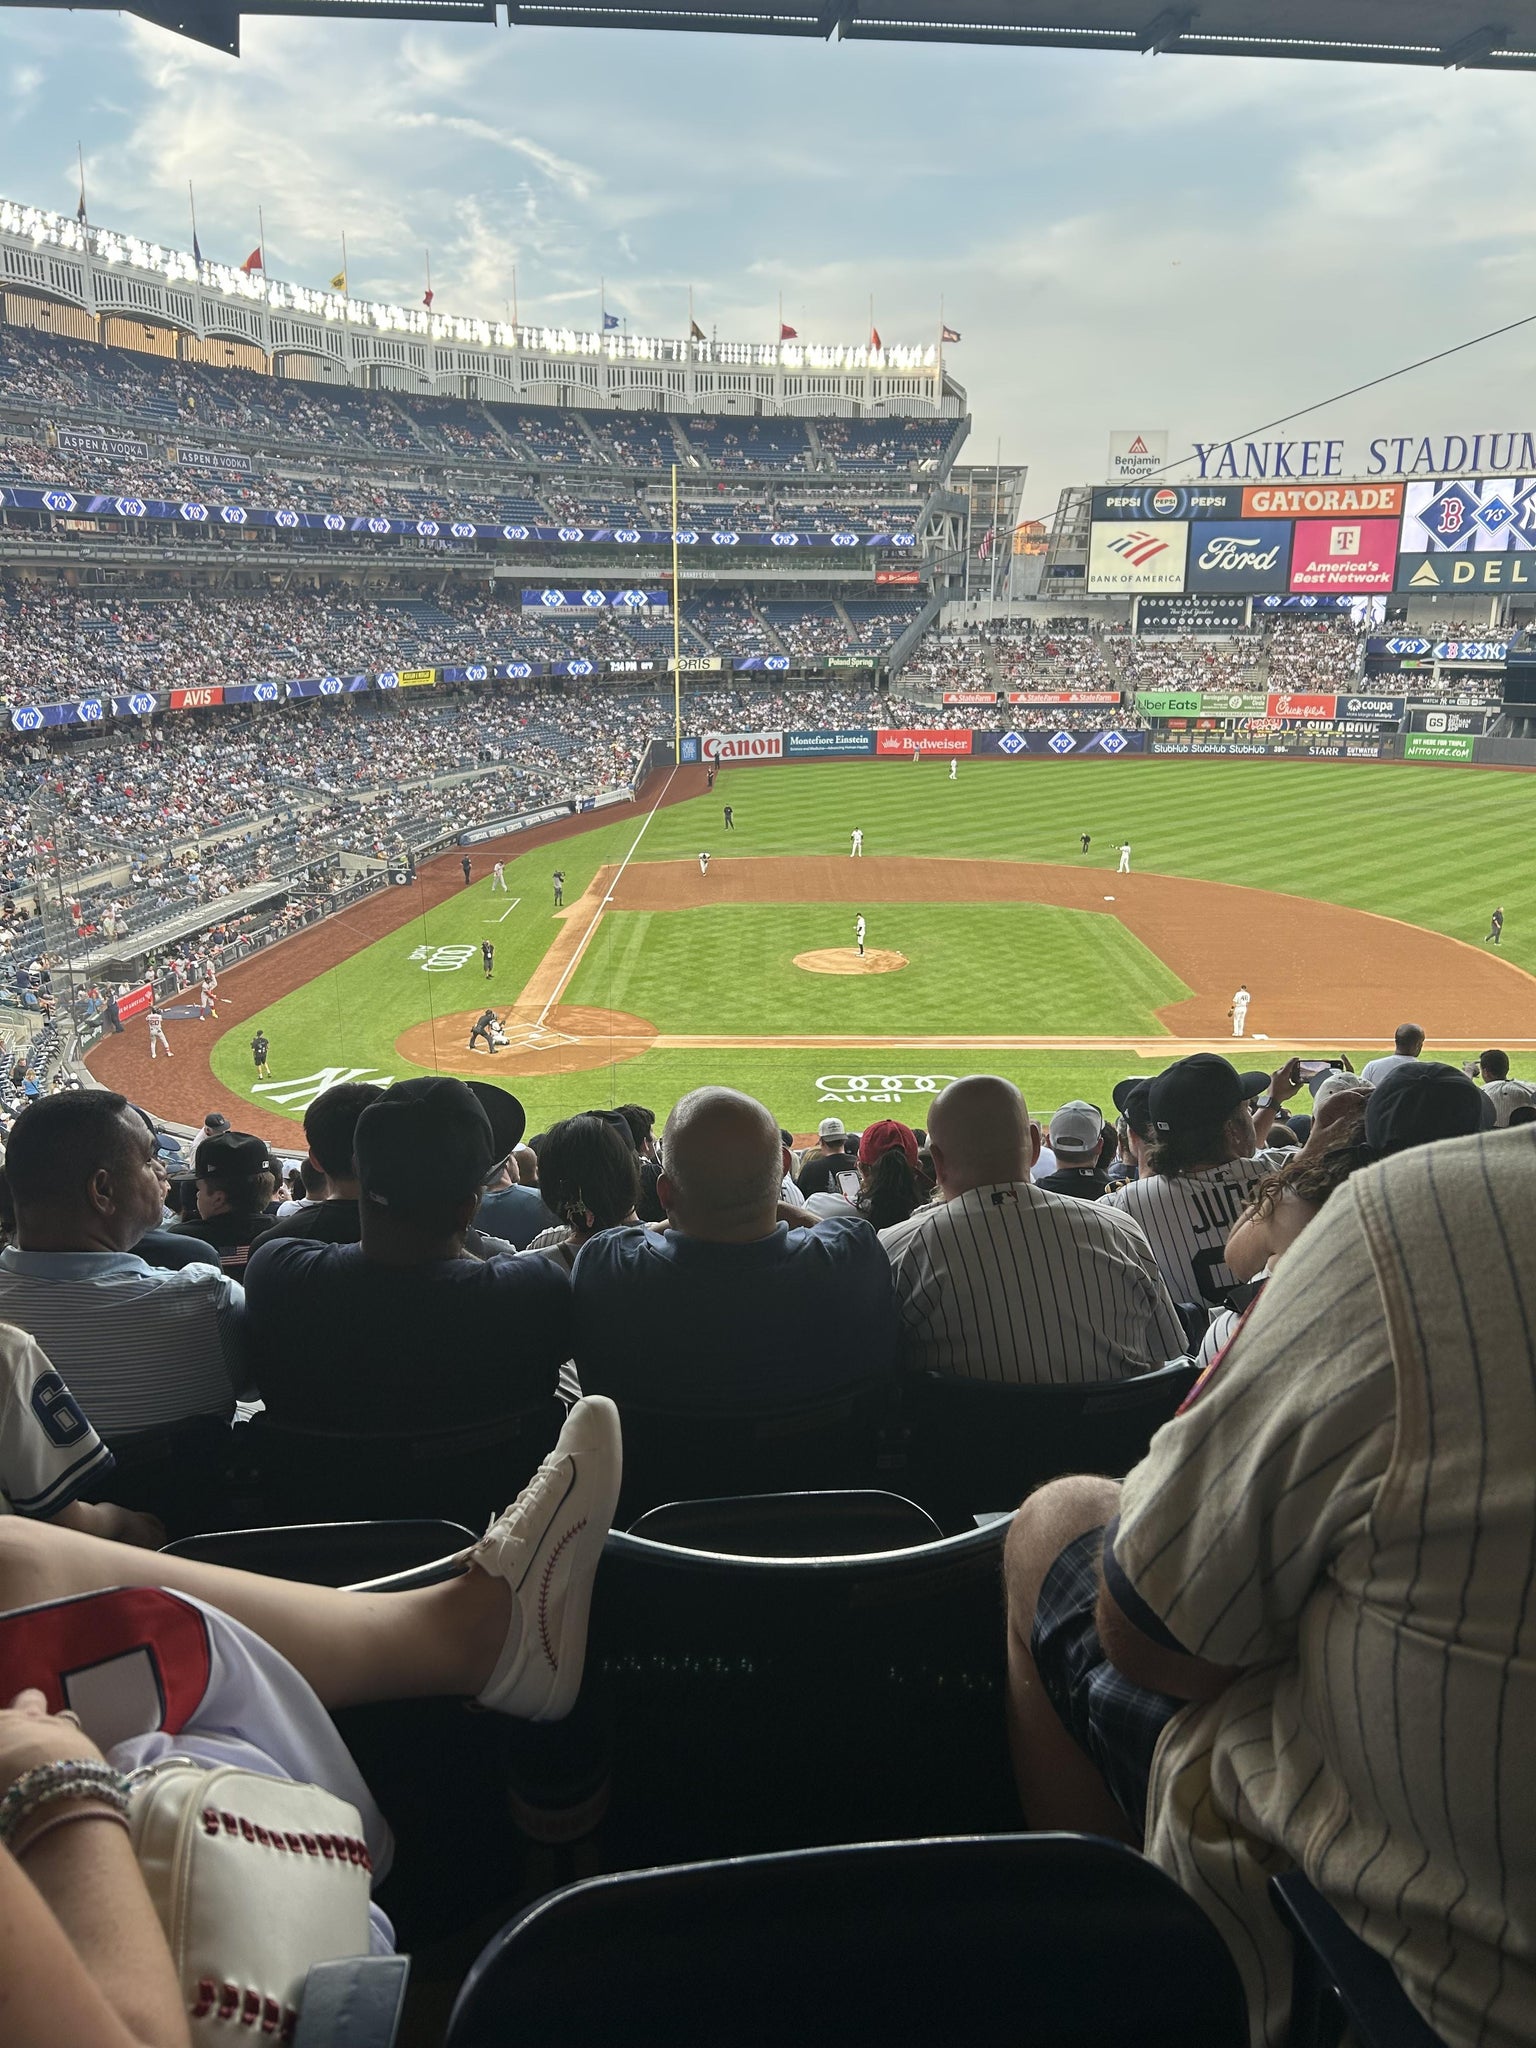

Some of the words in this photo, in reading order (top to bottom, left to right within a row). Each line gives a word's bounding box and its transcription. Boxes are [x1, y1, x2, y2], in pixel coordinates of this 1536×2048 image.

[64, 437, 98, 449] ASPEN
[111, 443, 143, 455] VODKA
[182, 452, 210, 464] ASPEN
[220, 458, 247, 468] VODKA
[1115, 456, 1160, 467] Benjamin
[1192, 440, 1344, 479] YANKEE
[1120, 466, 1152, 475] Moore
[1106, 497, 1141, 507] PEPSI
[1191, 497, 1226, 507] PEPSI
[1252, 488, 1395, 511] GATORADE
[1337, 532, 1353, 550] T
[1198, 537, 1280, 570] Ford
[1306, 561, 1379, 572] America's
[1453, 560, 1536, 583] DEL
[1091, 575, 1118, 583] BANK
[1120, 575, 1133, 583] OF
[1135, 575, 1181, 583] AMERICA
[1293, 573, 1326, 583] Best
[1327, 572, 1391, 583] Network
[678, 659, 710, 669] ORIS
[828, 658, 850, 667] Poland
[851, 658, 873, 667] Spring
[183, 689, 212, 706] AVIS
[1138, 699, 1167, 710] Uber
[1169, 699, 1198, 710] Eats
[1362, 701, 1393, 712] coupa
[1429, 718, 1443, 727] GS
[790, 736, 834, 745] Montefiore
[835, 735, 869, 744] Einstein
[903, 738, 967, 750] Budweiser
[703, 736, 780, 758] Canon
[1154, 744, 1188, 753] StubHub
[1191, 744, 1226, 753] StubHub
[1229, 744, 1265, 754] StubHub
[1309, 746, 1339, 756] STARR
[1408, 746, 1469, 758] NITTOTIRE.COM
[817, 1093, 902, 1103] Audi
[31, 1370, 92, 1447] 6
